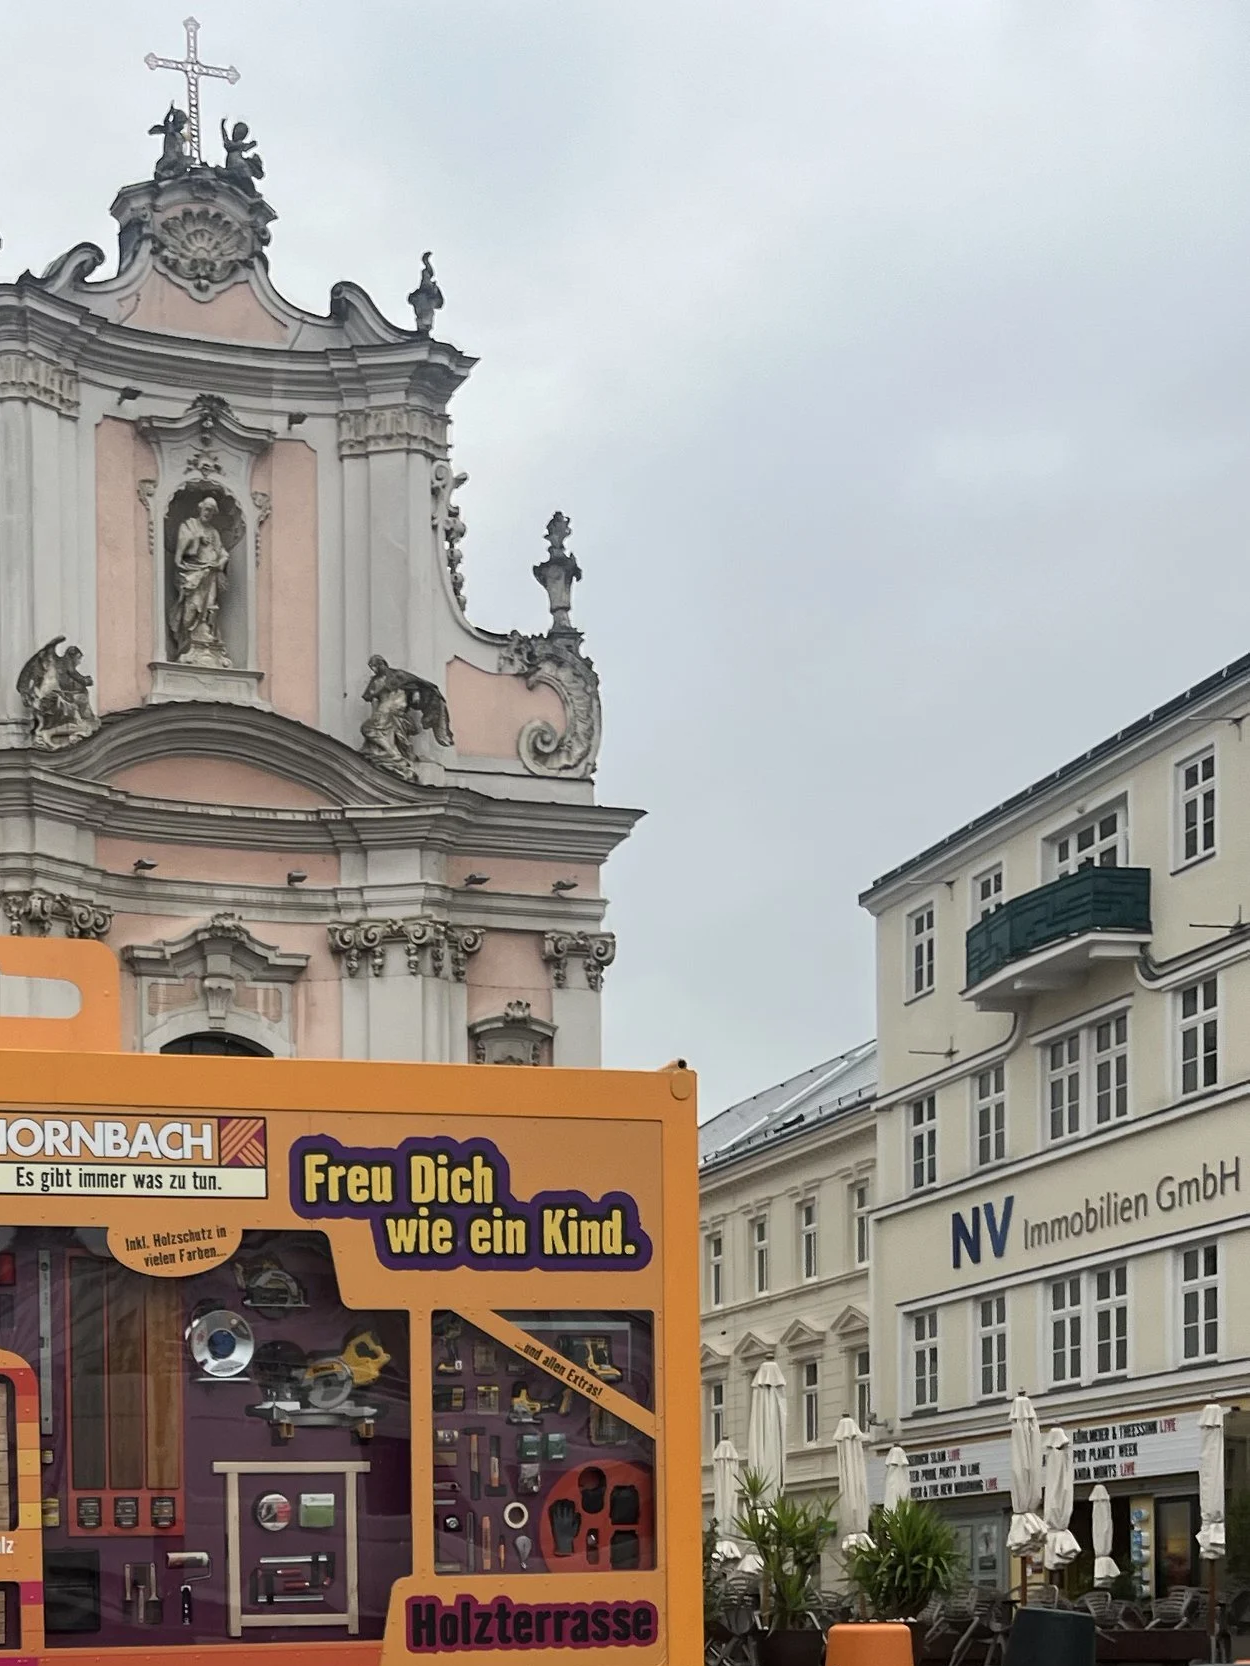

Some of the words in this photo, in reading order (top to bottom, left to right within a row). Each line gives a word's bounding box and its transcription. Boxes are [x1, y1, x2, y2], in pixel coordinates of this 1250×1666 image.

[16, 1167, 34, 1188] Es
[40, 1167, 73, 1192] gibt
[78, 1168, 127, 1189] immer
[133, 1174, 163, 1190] was
[169, 1174, 187, 1191] zu
[192, 1171, 223, 1191] tun.
[304, 1154, 393, 1203] Freu
[410, 1154, 494, 1204] Dich
[386, 1207, 453, 1254] wie
[470, 1207, 526, 1254] ein
[543, 1208, 636, 1255] Kind.
[951, 1195, 1015, 1269] NV
[1023, 1191, 1149, 1251] Immobilien
[1155, 1156, 1241, 1213] GmbH
[125, 1235, 150, 1251] Inkl.
[153, 1228, 213, 1247] Holzschutz
[216, 1225, 227, 1238] in
[143, 1252, 176, 1267] vielen
[542, 1355, 567, 1376] allen
[566, 1368, 604, 1399] Extras!
[412, 1601, 653, 1647] Holzterrasse
